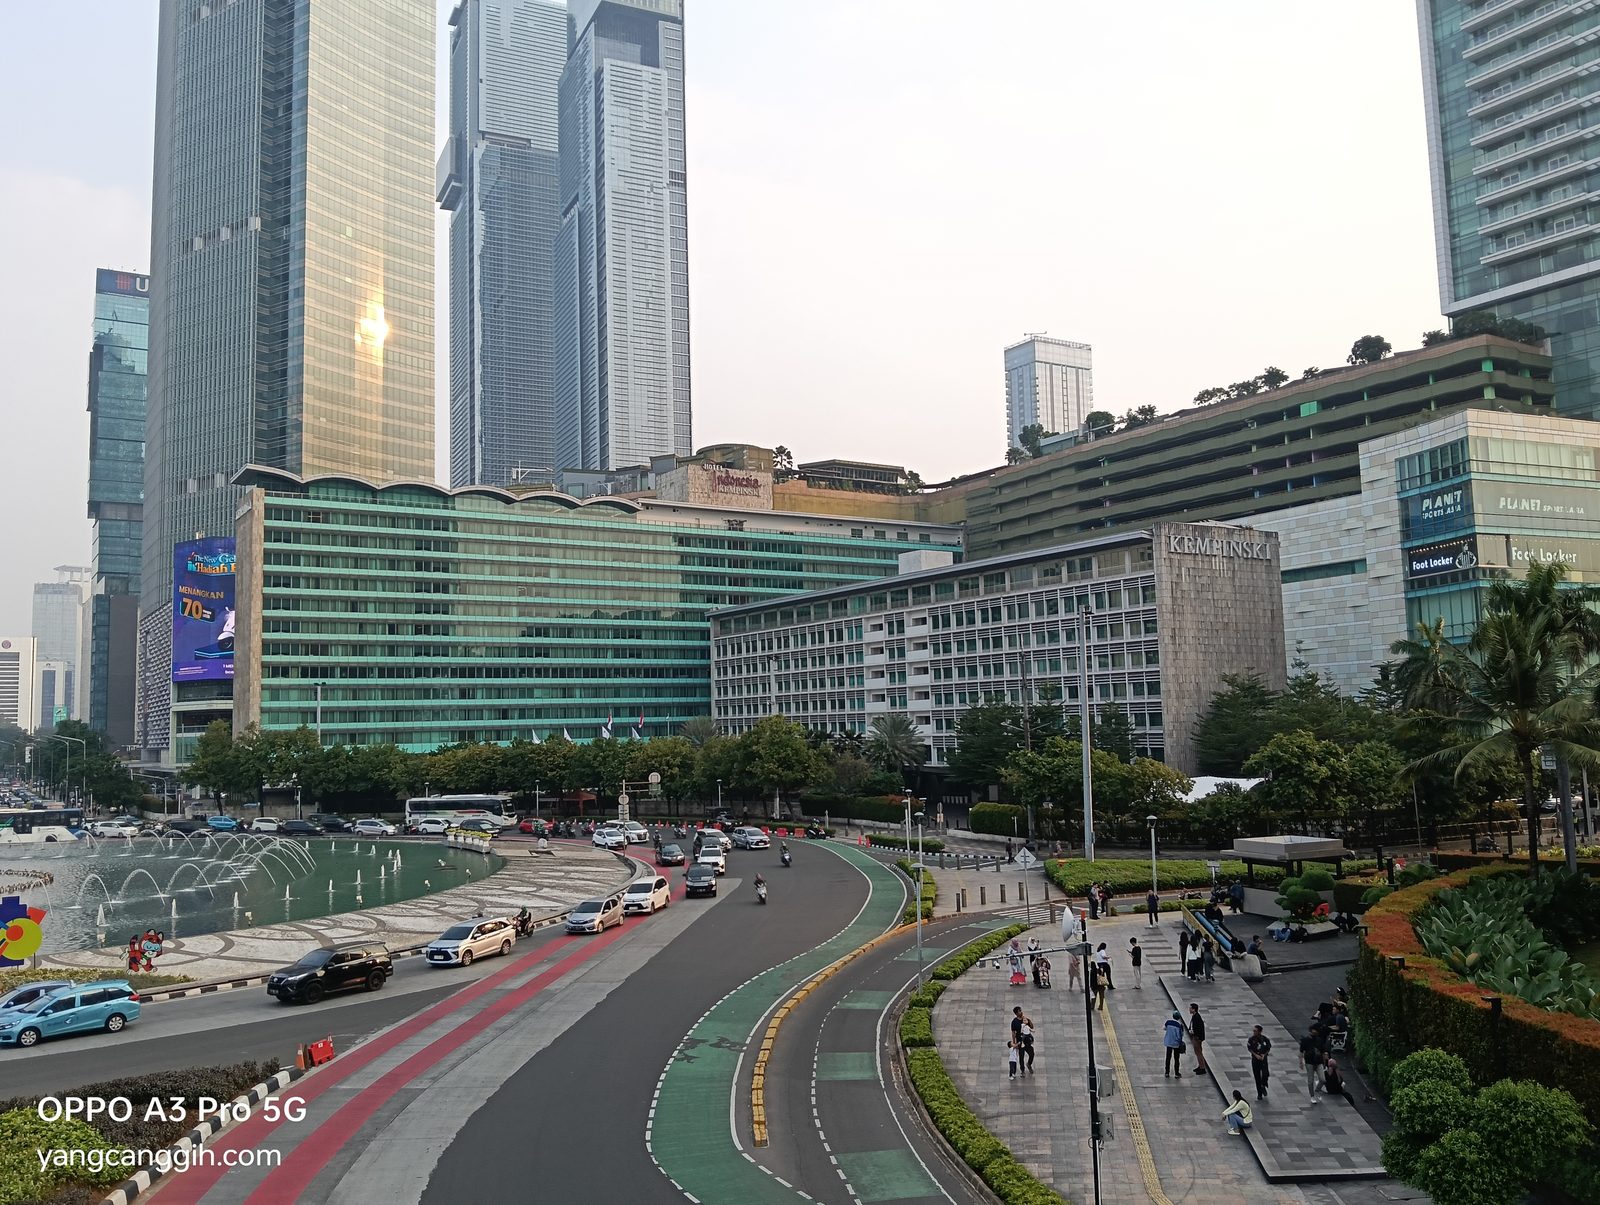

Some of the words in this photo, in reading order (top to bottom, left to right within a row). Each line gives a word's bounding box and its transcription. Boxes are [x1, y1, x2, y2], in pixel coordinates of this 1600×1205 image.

[702, 463, 723, 471] HOTEL
[1168, 534, 1271, 560] KEMPINSKI
[194, 562, 228, 573] Hadiah
[1412, 560, 1429, 571] Foot
[1429, 556, 1454, 568] Locker
[178, 585, 224, 599] MENANGKAN
[182, 597, 203, 620] 70
